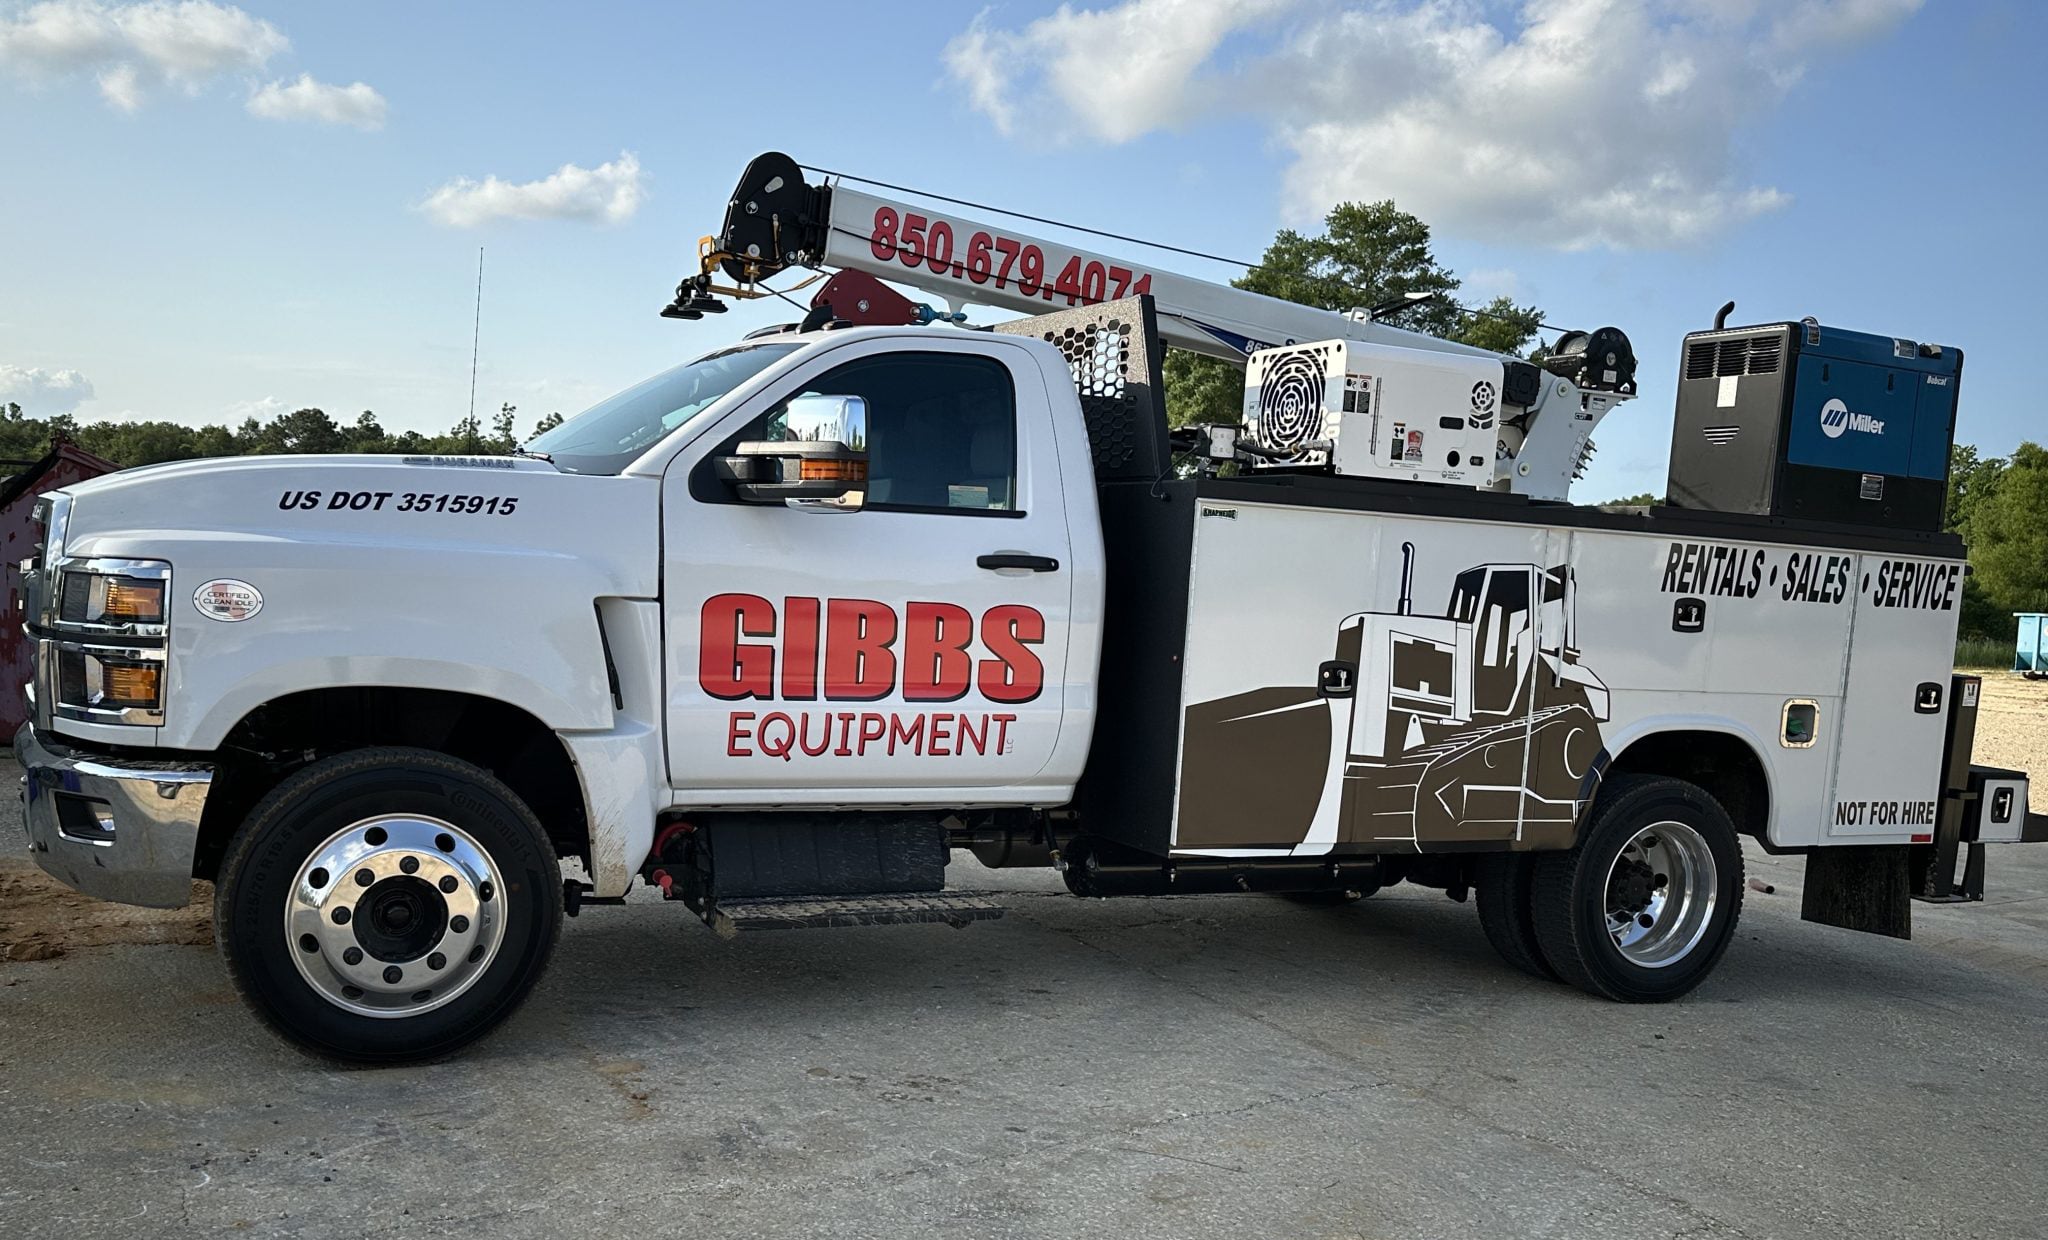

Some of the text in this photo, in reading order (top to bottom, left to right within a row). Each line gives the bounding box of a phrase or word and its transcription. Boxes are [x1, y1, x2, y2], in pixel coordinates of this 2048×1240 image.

[1848, 412, 1885, 434] Miller
[278, 491, 519, 515] US DOT 3515915
[1660, 542, 1960, 611] RENTALS SALES SERVICE
[207, 591, 250, 600] CERTIFIED
[699, 592, 1045, 704] GIBBS
[727, 711, 1017, 762] EQUIPMENT
[1836, 801, 1935, 825] NOT FOR HIRE
